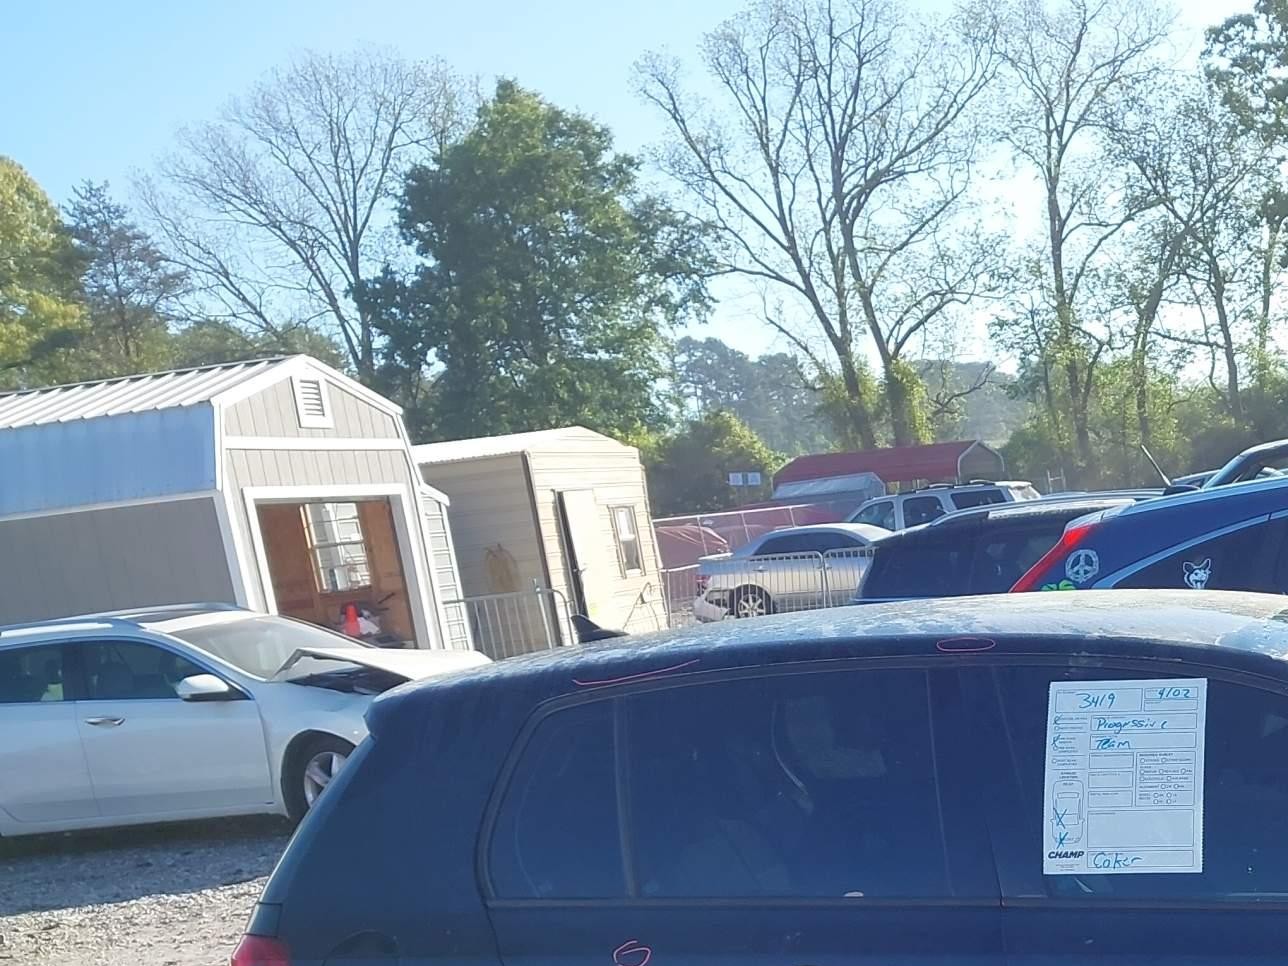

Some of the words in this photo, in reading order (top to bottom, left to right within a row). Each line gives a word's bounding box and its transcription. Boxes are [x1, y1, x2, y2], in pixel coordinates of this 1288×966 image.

[1158, 687, 1191, 699] 4/02
[1075, 692, 1116, 709] 3419
[1047, 850, 1085, 859] CHAMP
